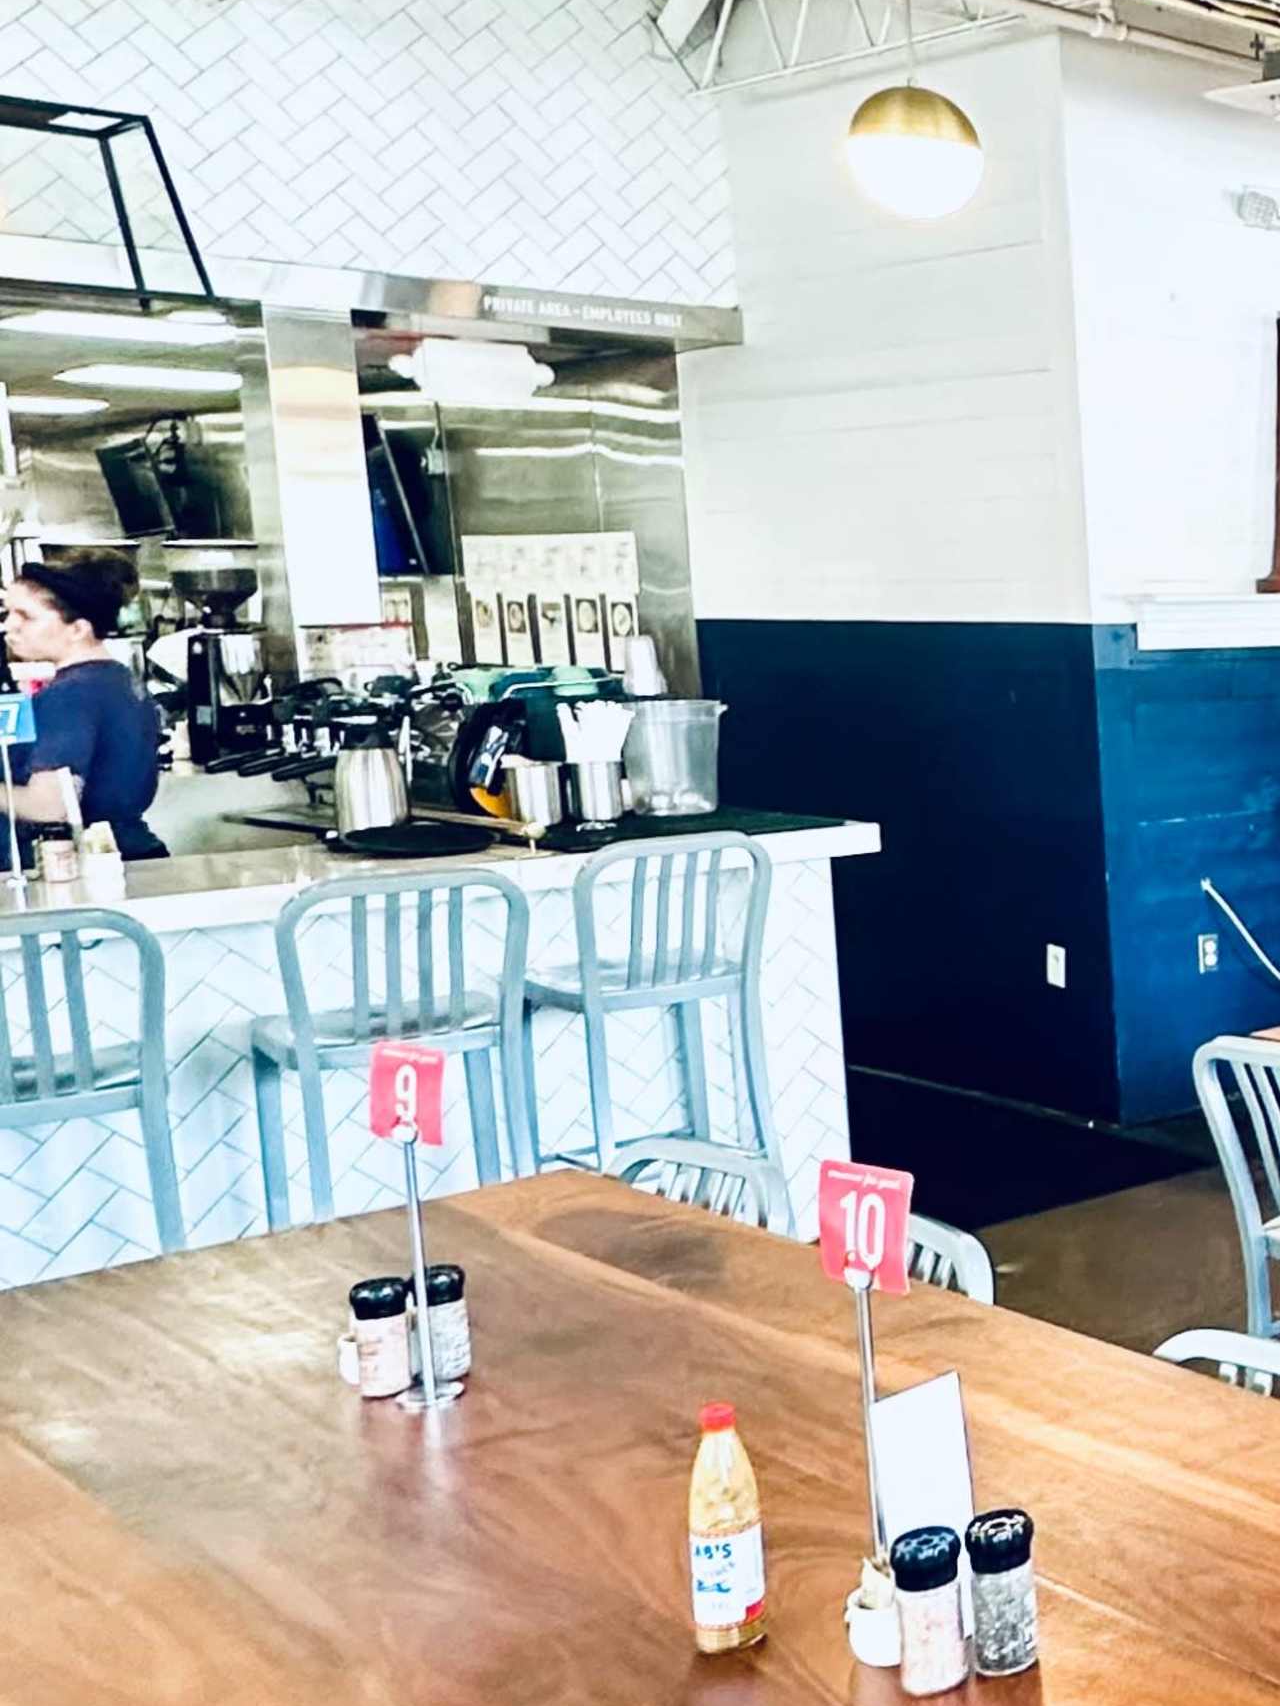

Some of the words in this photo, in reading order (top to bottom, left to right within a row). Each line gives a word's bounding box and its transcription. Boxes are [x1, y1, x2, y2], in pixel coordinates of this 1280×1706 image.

[483, 295, 535, 314] PRIVATE
[539, 301, 571, 318] AREA
[395, 1064, 418, 1122] 9
[839, 1190, 886, 1271] 10
